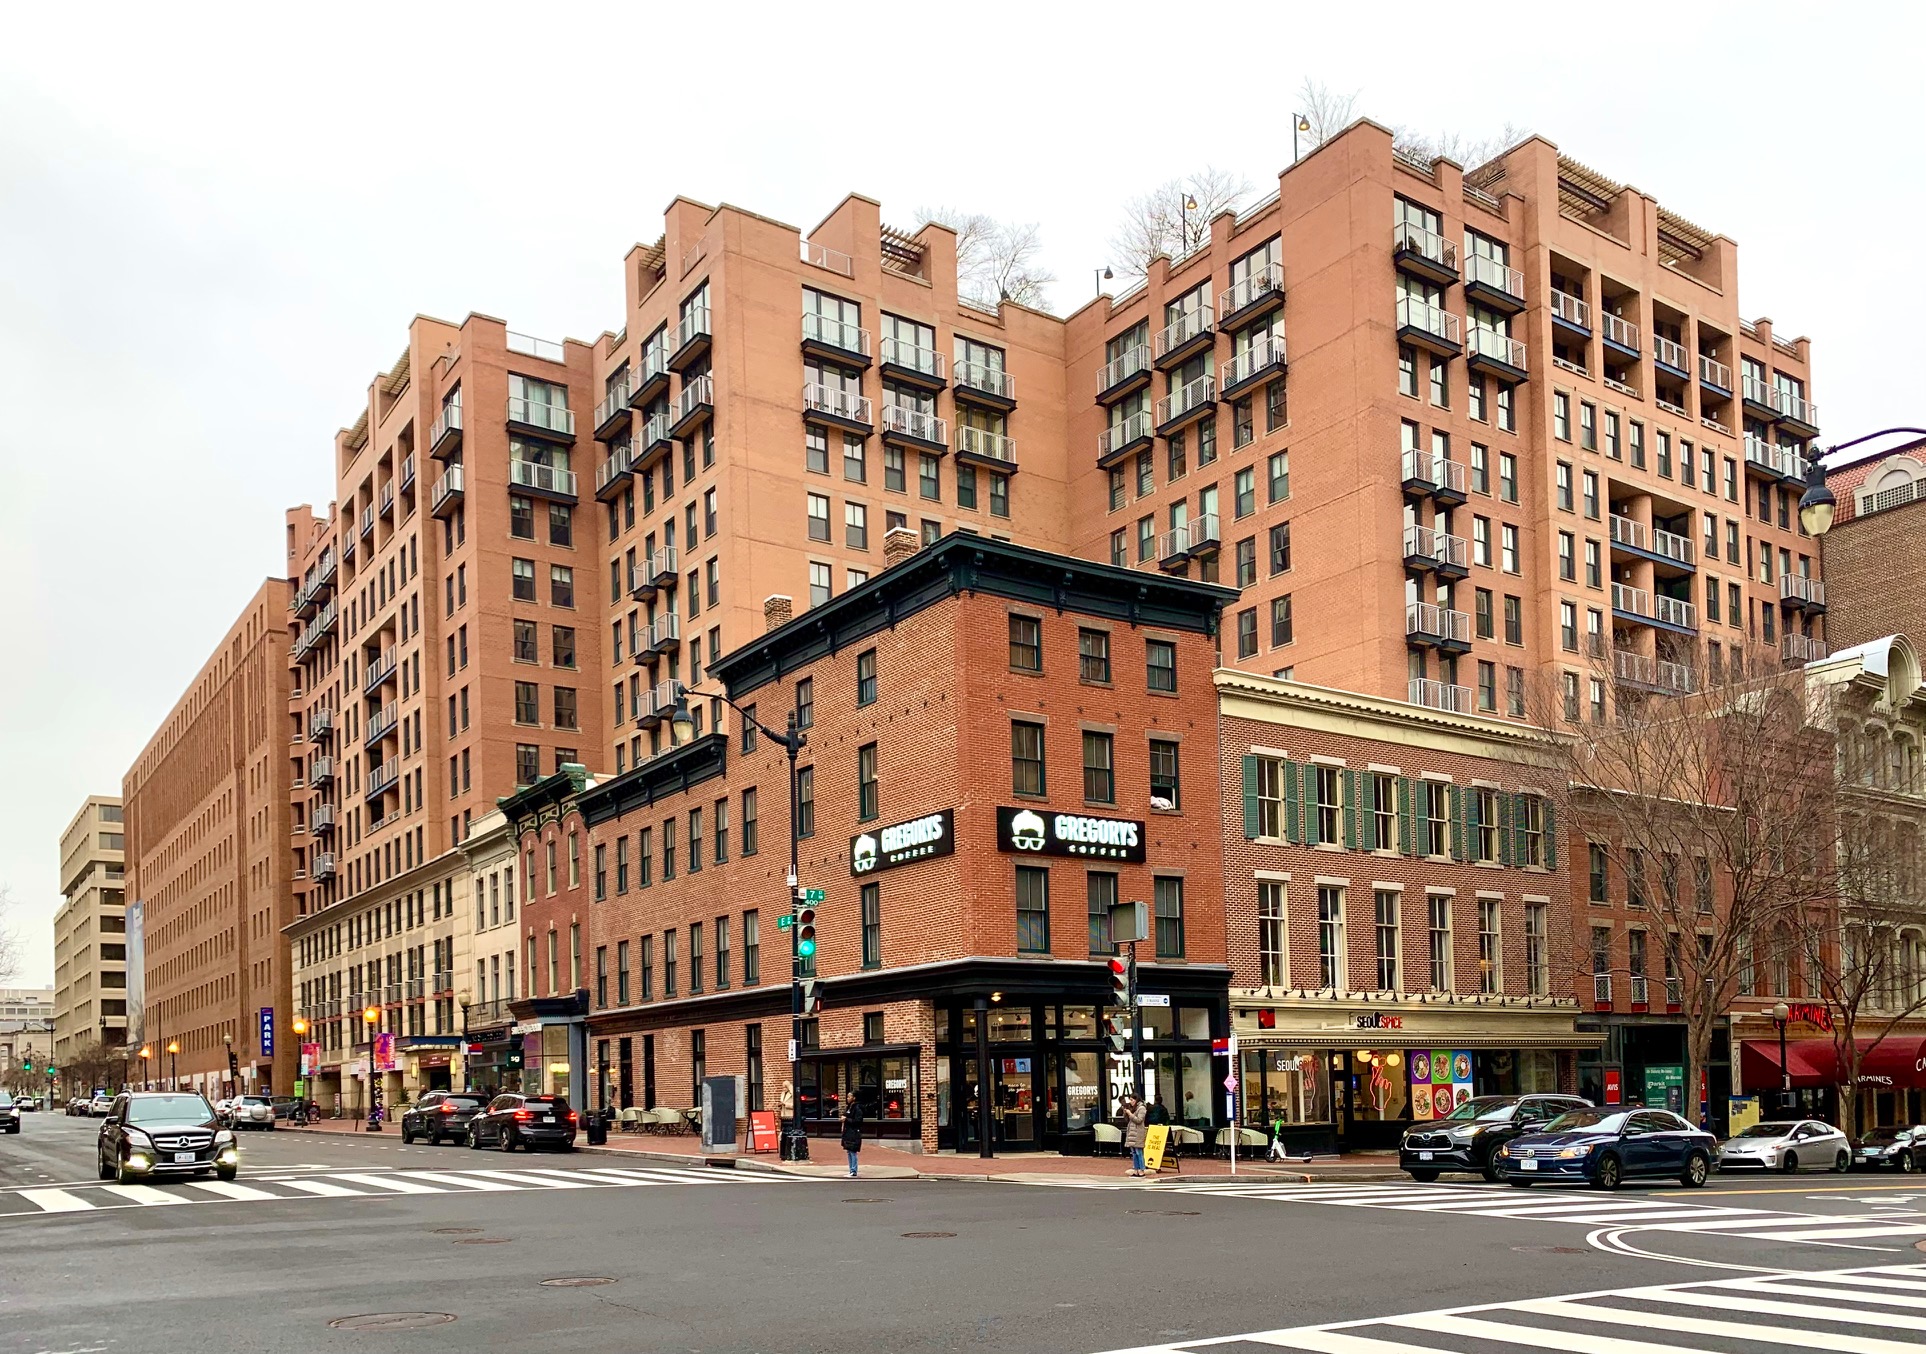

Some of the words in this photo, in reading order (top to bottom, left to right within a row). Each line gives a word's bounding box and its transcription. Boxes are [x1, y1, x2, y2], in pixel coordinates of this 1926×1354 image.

[881, 814, 943, 853] GREGORYS
[1054, 814, 1139, 848] GREGORYS
[889, 845, 935, 863] COFFEE
[1068, 844, 1128, 858] COFFEE
[809, 890, 816, 899] 7
[781, 917, 786, 926] E
[263, 1015, 272, 1047] PARK
[1067, 1085, 1098, 1096] GREGORYS
